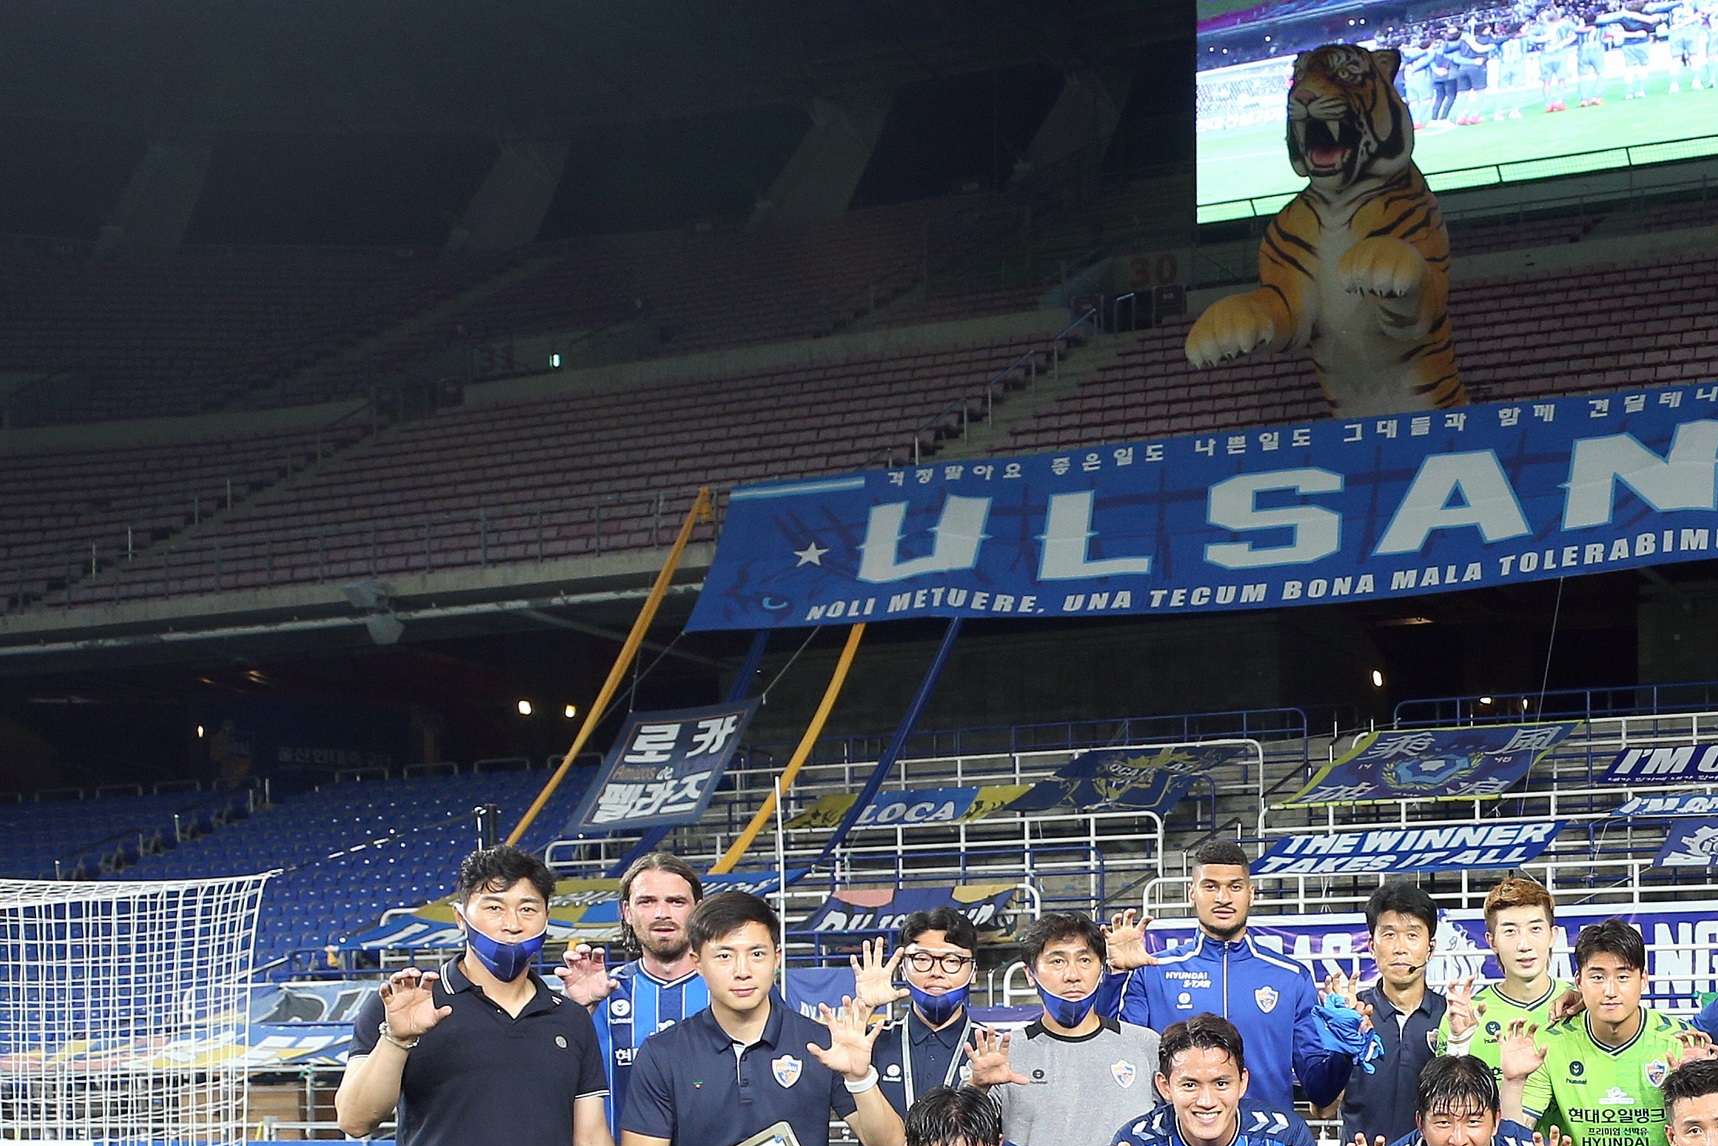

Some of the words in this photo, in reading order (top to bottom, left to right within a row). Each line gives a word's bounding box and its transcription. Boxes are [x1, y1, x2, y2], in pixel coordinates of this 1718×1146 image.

[1051, 443, 1164, 476] 좋은일도
[1194, 427, 1312, 457] 나쁜일도
[1343, 411, 1467, 443] 그대들과
[1498, 403, 1556, 427] 함께
[805, 597, 876, 622] NOLI
[886, 586, 1046, 615] METUERE,
[1062, 590, 1133, 612] UNA
[1149, 582, 1270, 609] TECUM
[1280, 573, 1376, 601] BONA
[1390, 560, 1483, 590] MALA
[623, 714, 739, 764] 로카
[1613, 745, 1695, 775] I'M
[855, 800, 957, 826] LOCA
[1282, 831, 1365, 856] THE
[1364, 822, 1556, 854] WINNER
[1257, 854, 1399, 874] TAKES
[1399, 850, 1448, 869] IT
[1449, 846, 1528, 866] ALL
[1165, 971, 1209, 981] HYUNDAI
[1568, 1107, 1666, 1124] 현대오일뱅크
[1588, 1127, 1622, 1137] 프리미엄
